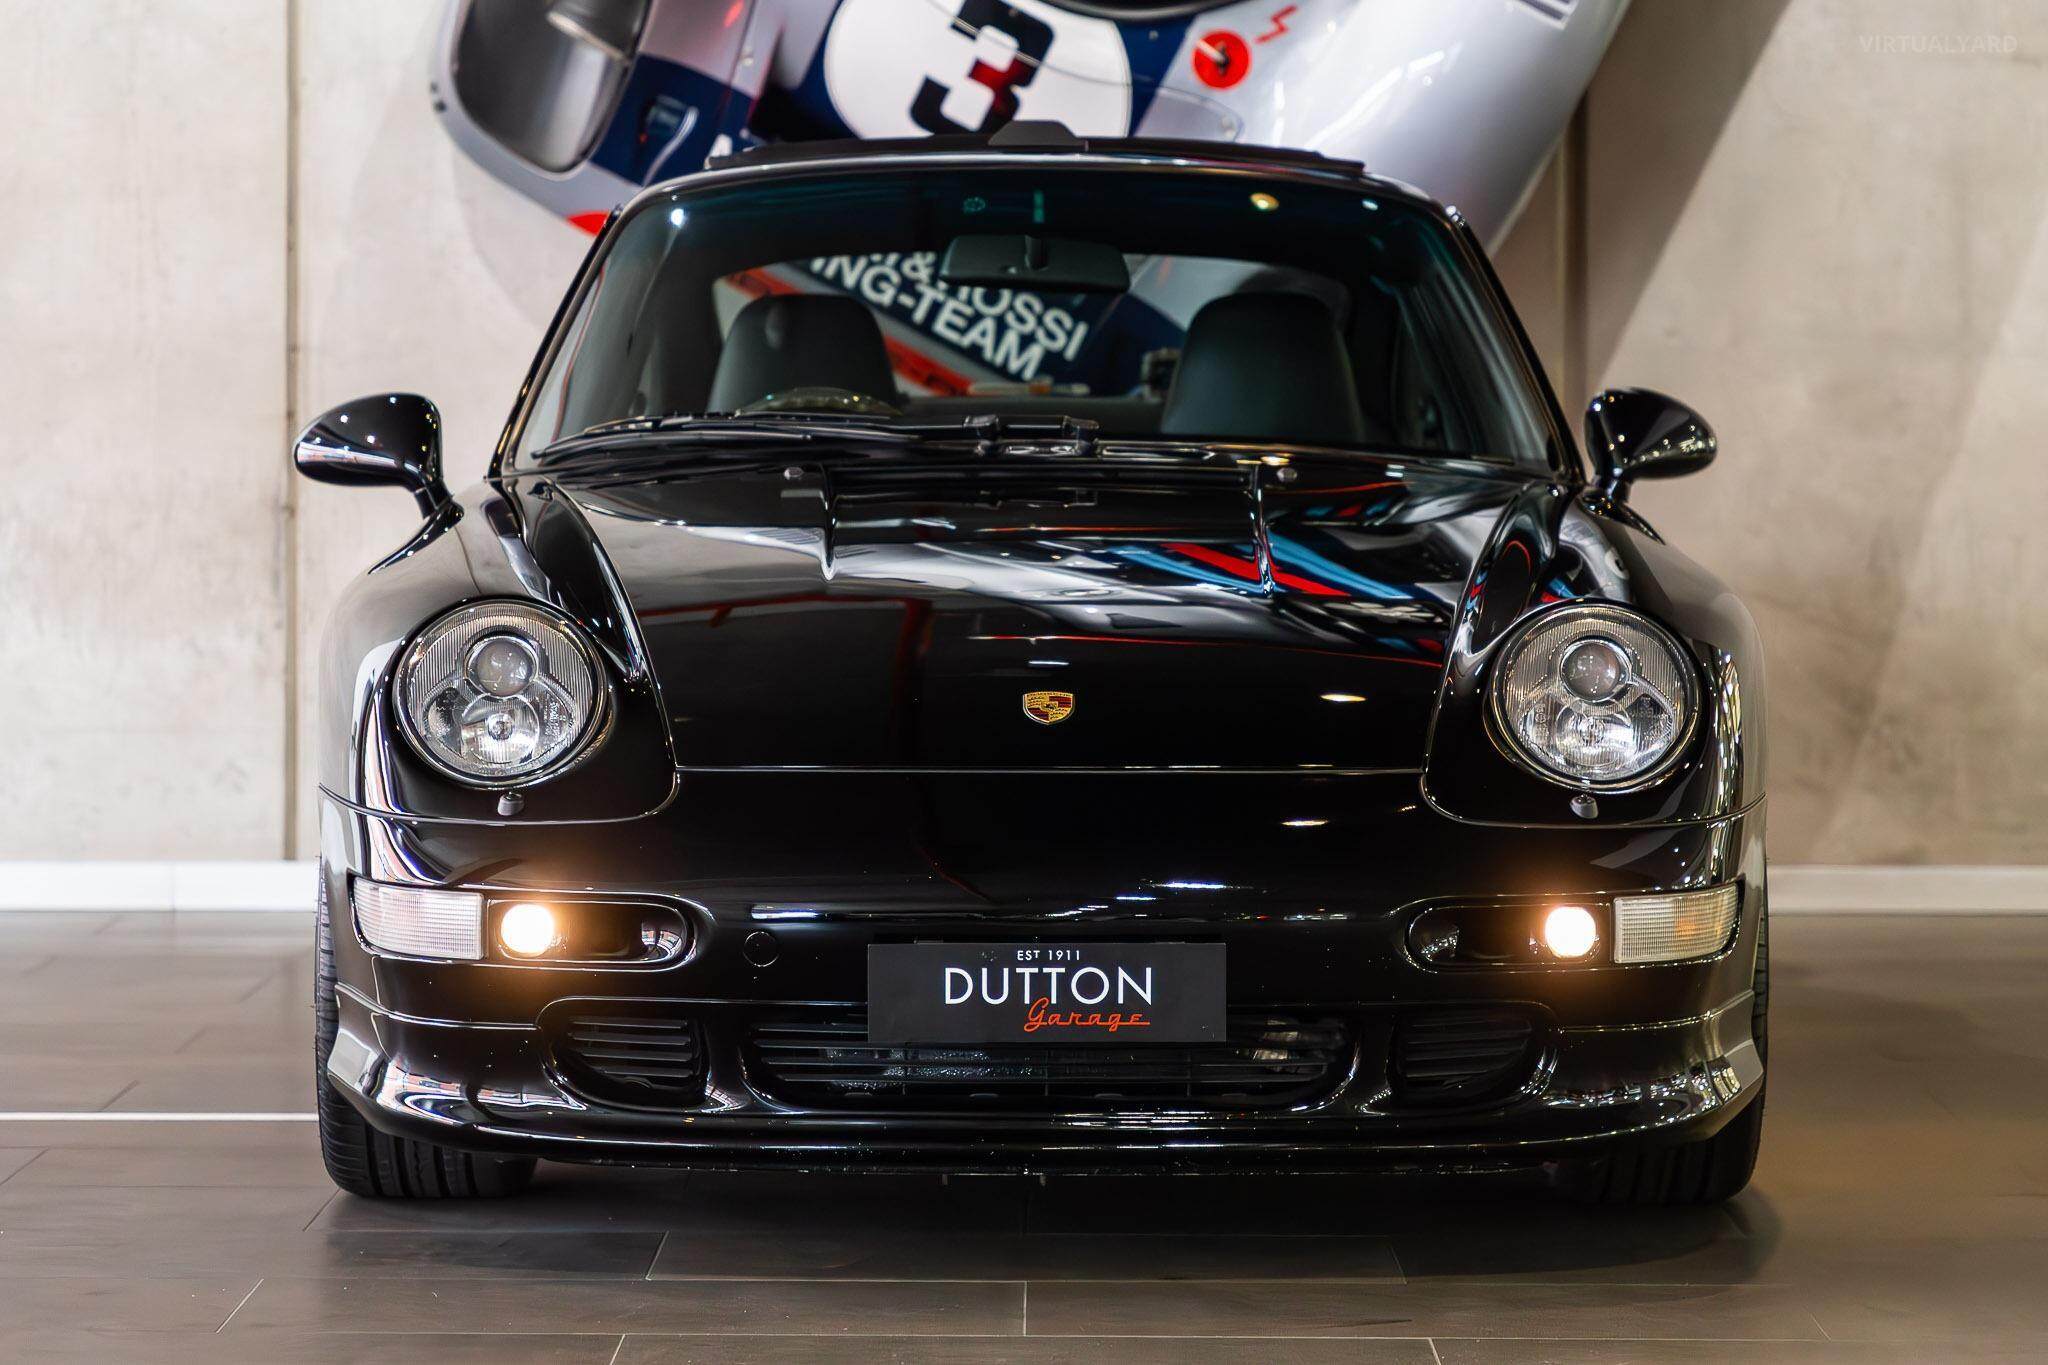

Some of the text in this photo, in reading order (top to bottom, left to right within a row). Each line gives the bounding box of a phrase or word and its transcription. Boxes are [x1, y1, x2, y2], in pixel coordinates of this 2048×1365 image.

[910, 0, 1054, 135] 3
[937, 279, 1089, 362] OSSI
[1017, 950, 1081, 961] EST 1911
[945, 966, 1152, 1005] DUTTON
[1023, 996, 1151, 1032] Garage
